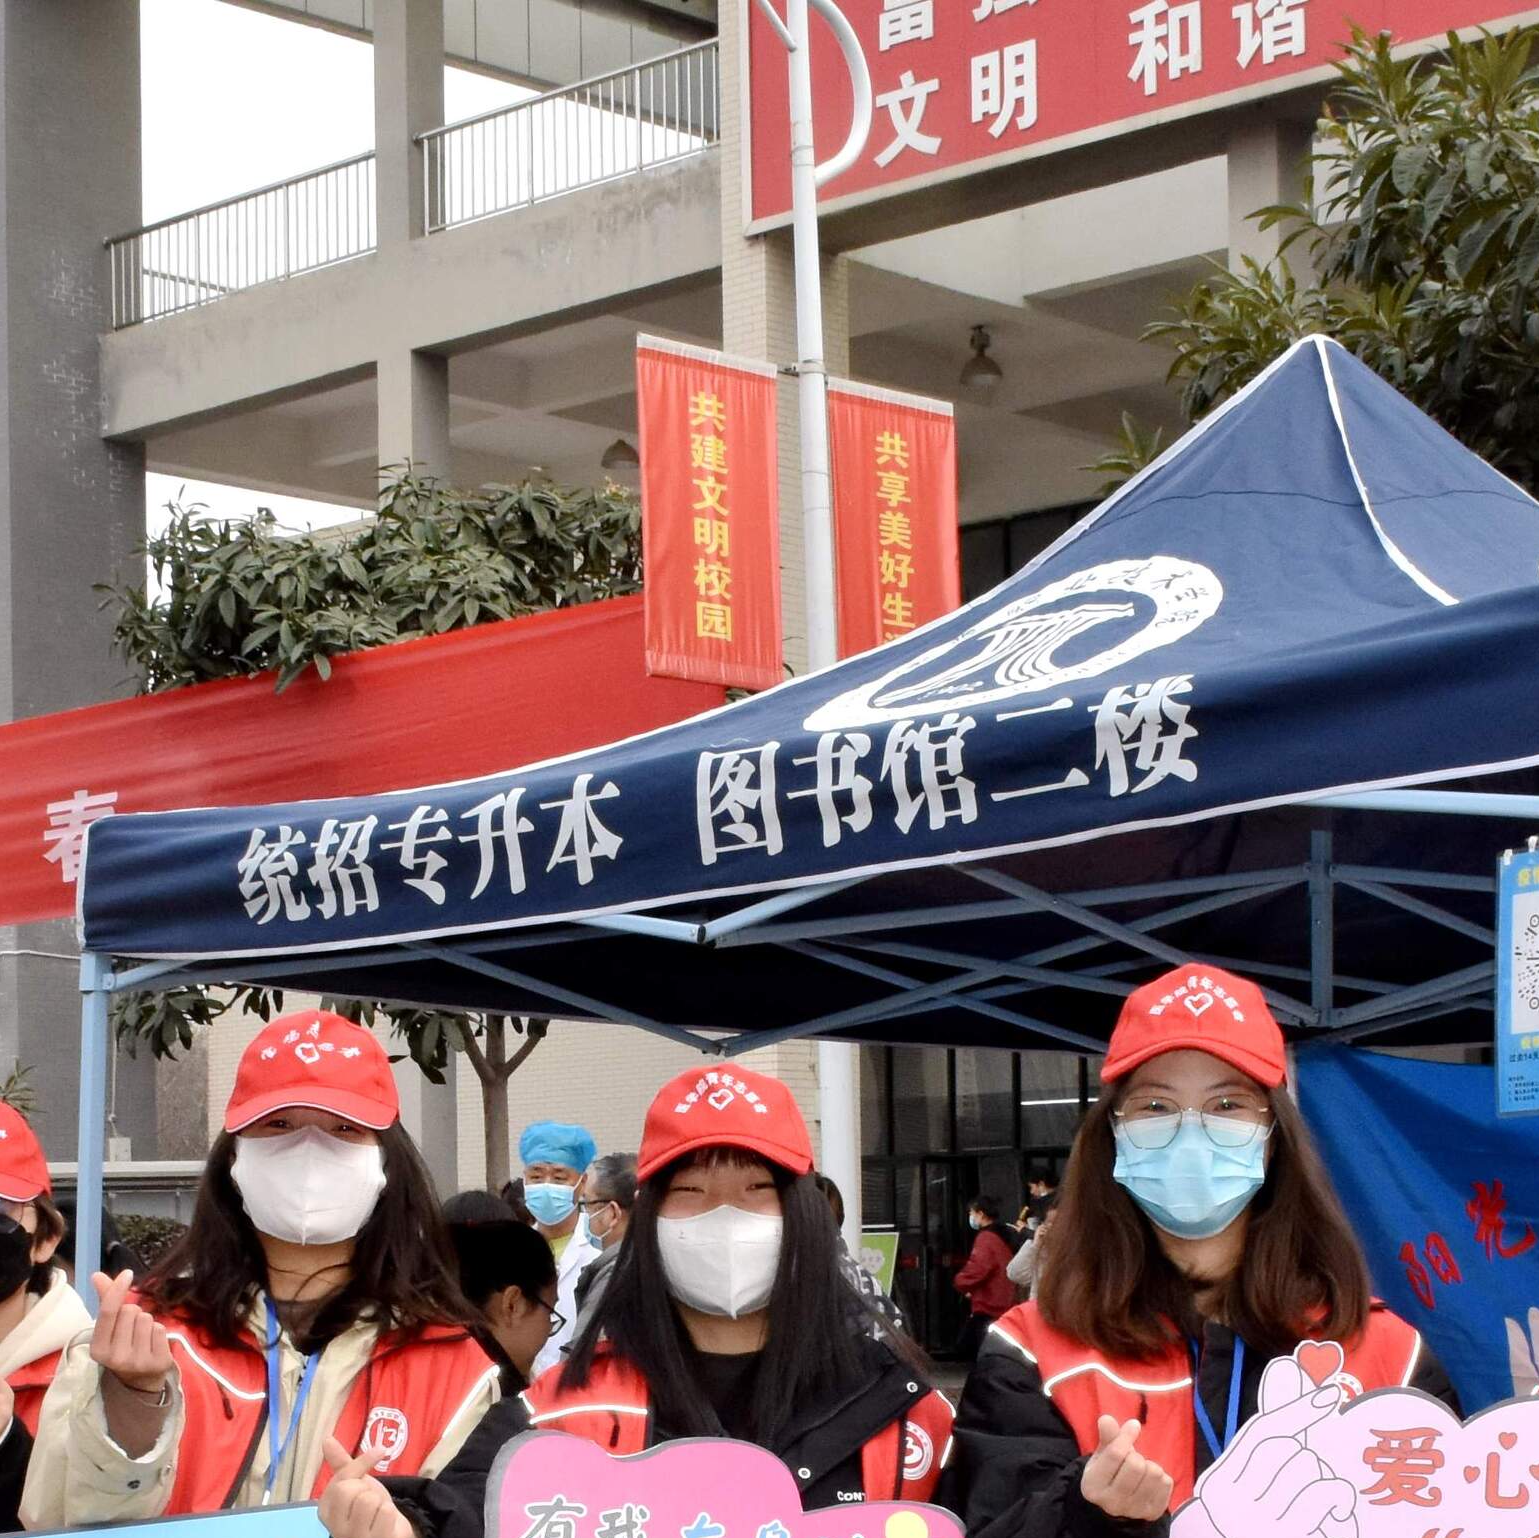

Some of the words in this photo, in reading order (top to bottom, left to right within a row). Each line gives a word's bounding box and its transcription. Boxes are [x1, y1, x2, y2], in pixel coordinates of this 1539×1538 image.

[874, 38, 1040, 168] 文明
[1128, 0, 1308, 96] 和谐
[689, 391, 733, 642] 共建文明校园
[875, 430, 916, 645] 共享美好生
[237, 773, 624, 925] 统招专升本
[696, 674, 1199, 867] 图书馆二楼
